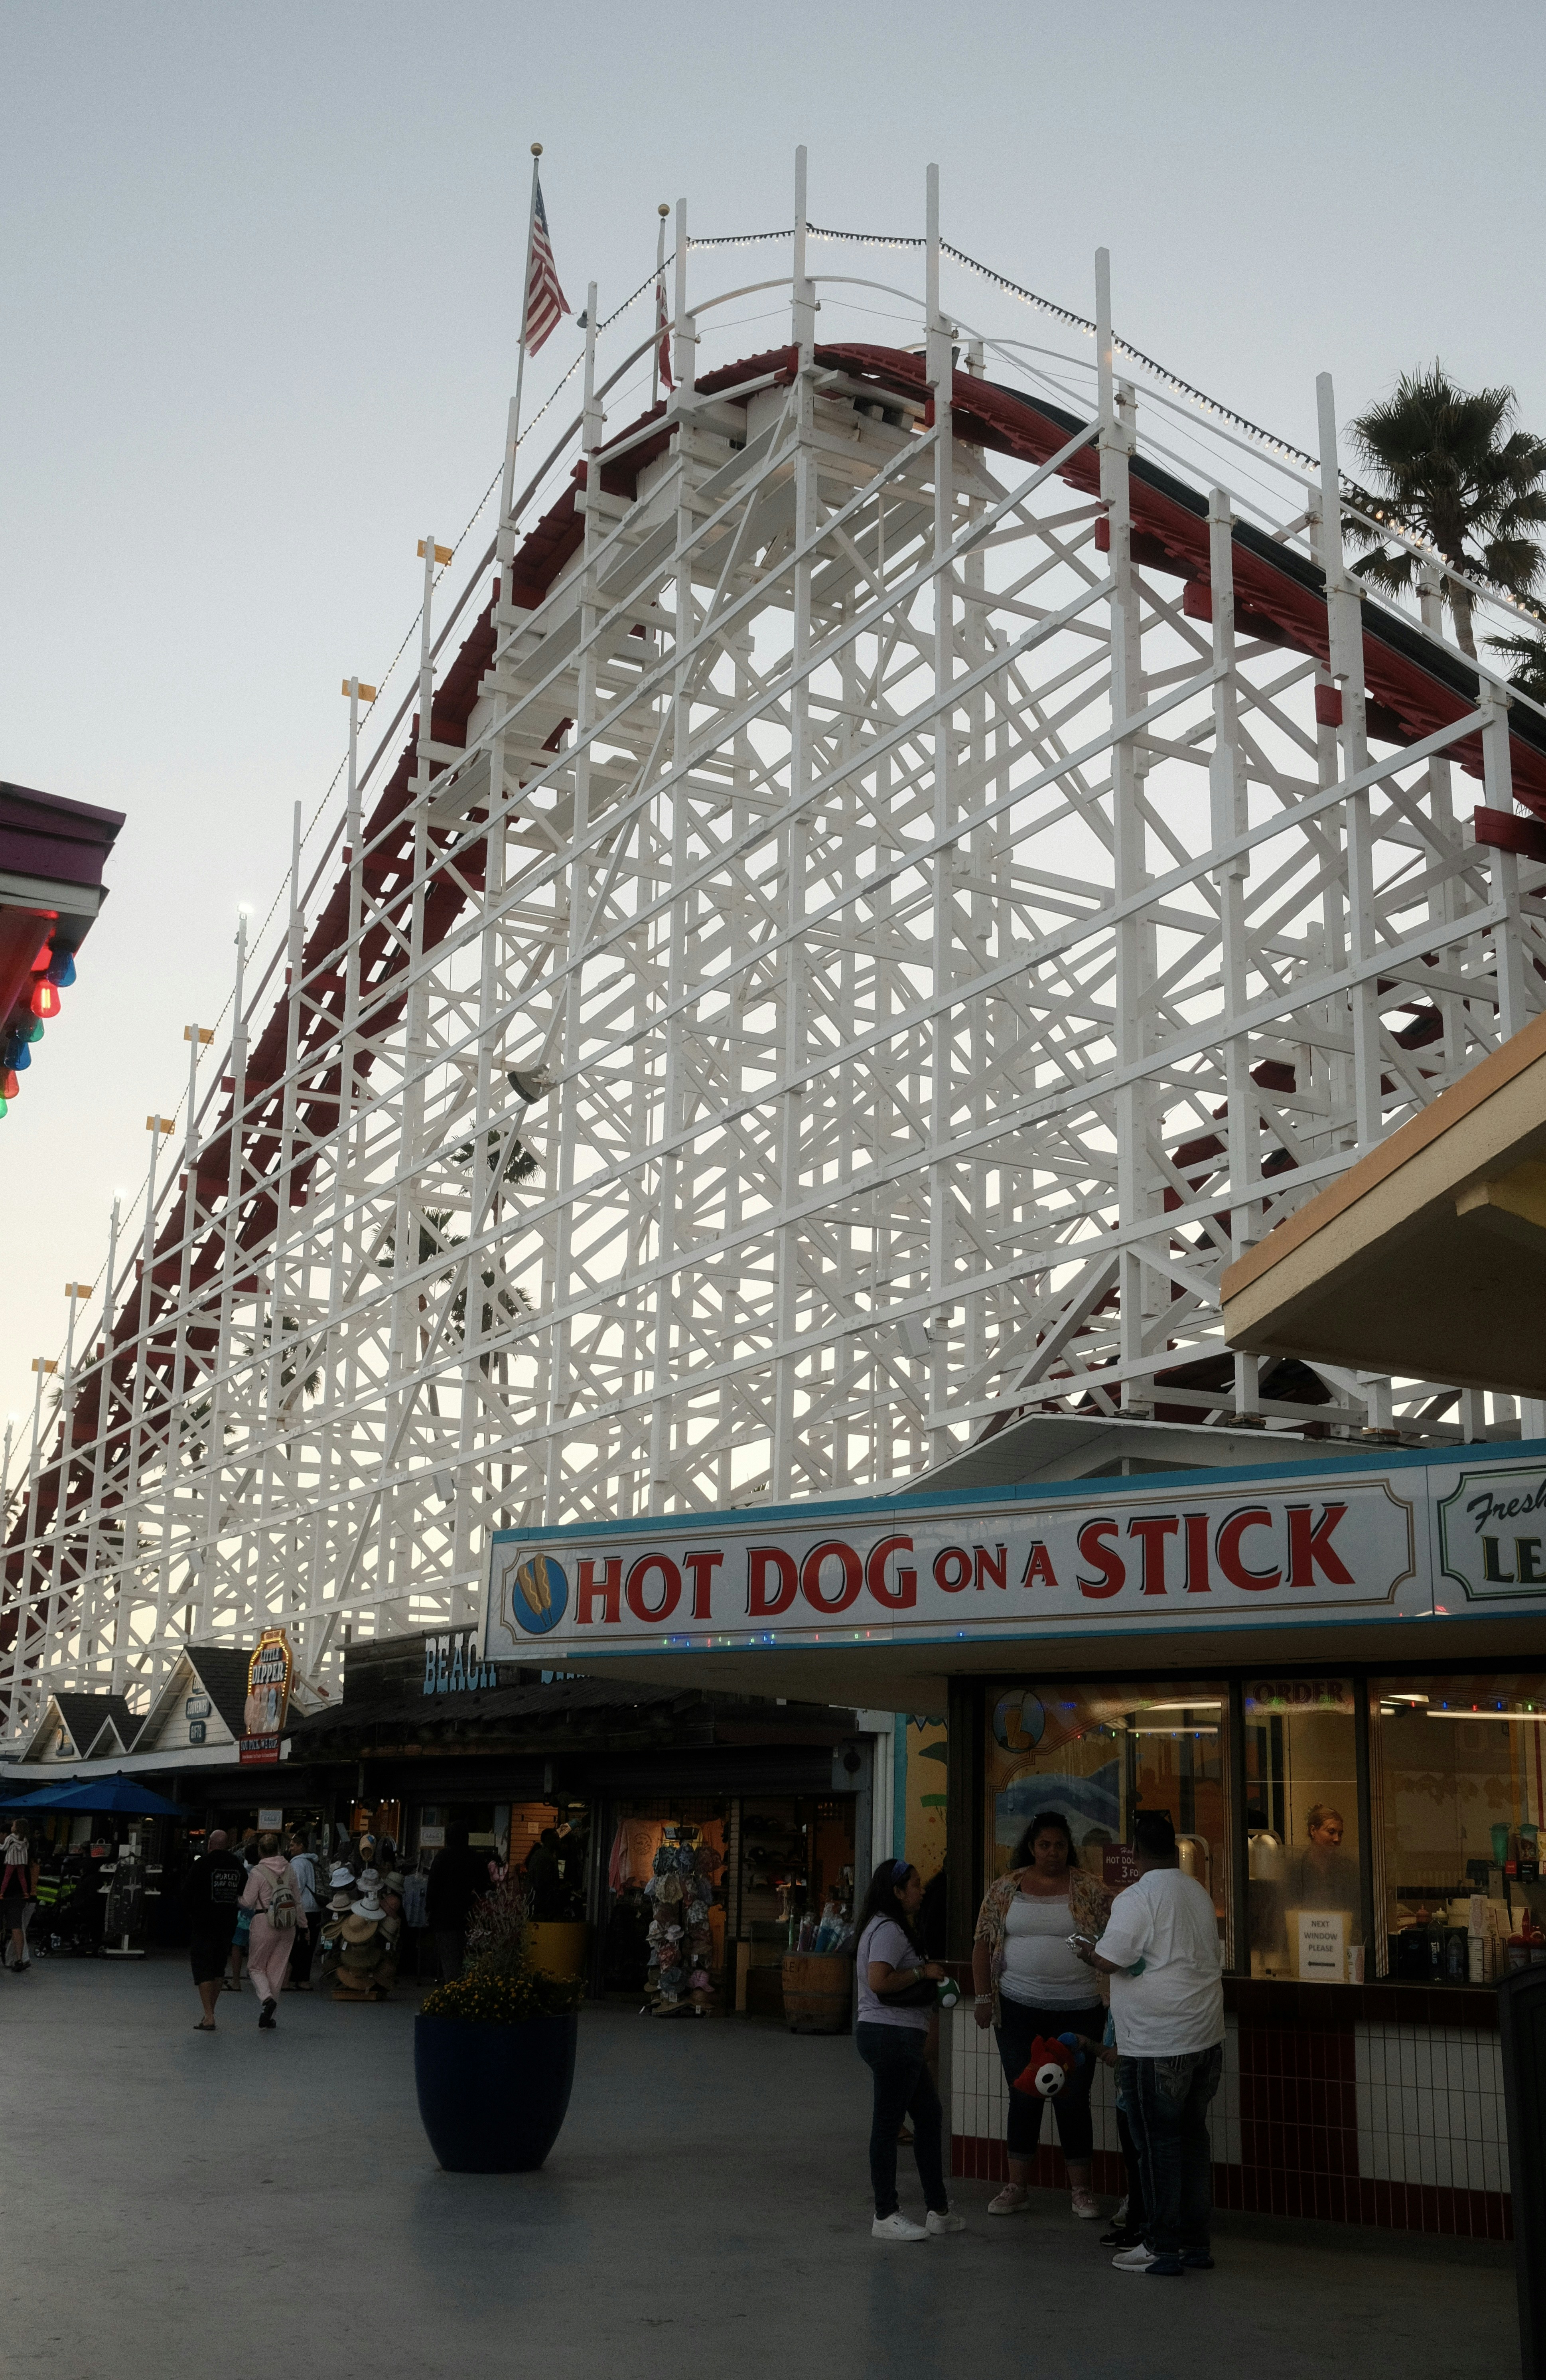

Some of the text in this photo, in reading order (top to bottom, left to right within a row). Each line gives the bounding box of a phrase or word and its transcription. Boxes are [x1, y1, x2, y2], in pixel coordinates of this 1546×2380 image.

[574, 1501, 1356, 1625] HOT DOG ON A STICK
[260, 1648, 280, 1662] LITTLE
[252, 1661, 284, 1684] DIPPER
[1253, 1681, 1345, 1705] ORDER
[187, 1699, 207, 1715] SOUVENIRS
[191, 1725, 202, 1739] GIFTS
[1122, 1866, 1128, 1878] 3
